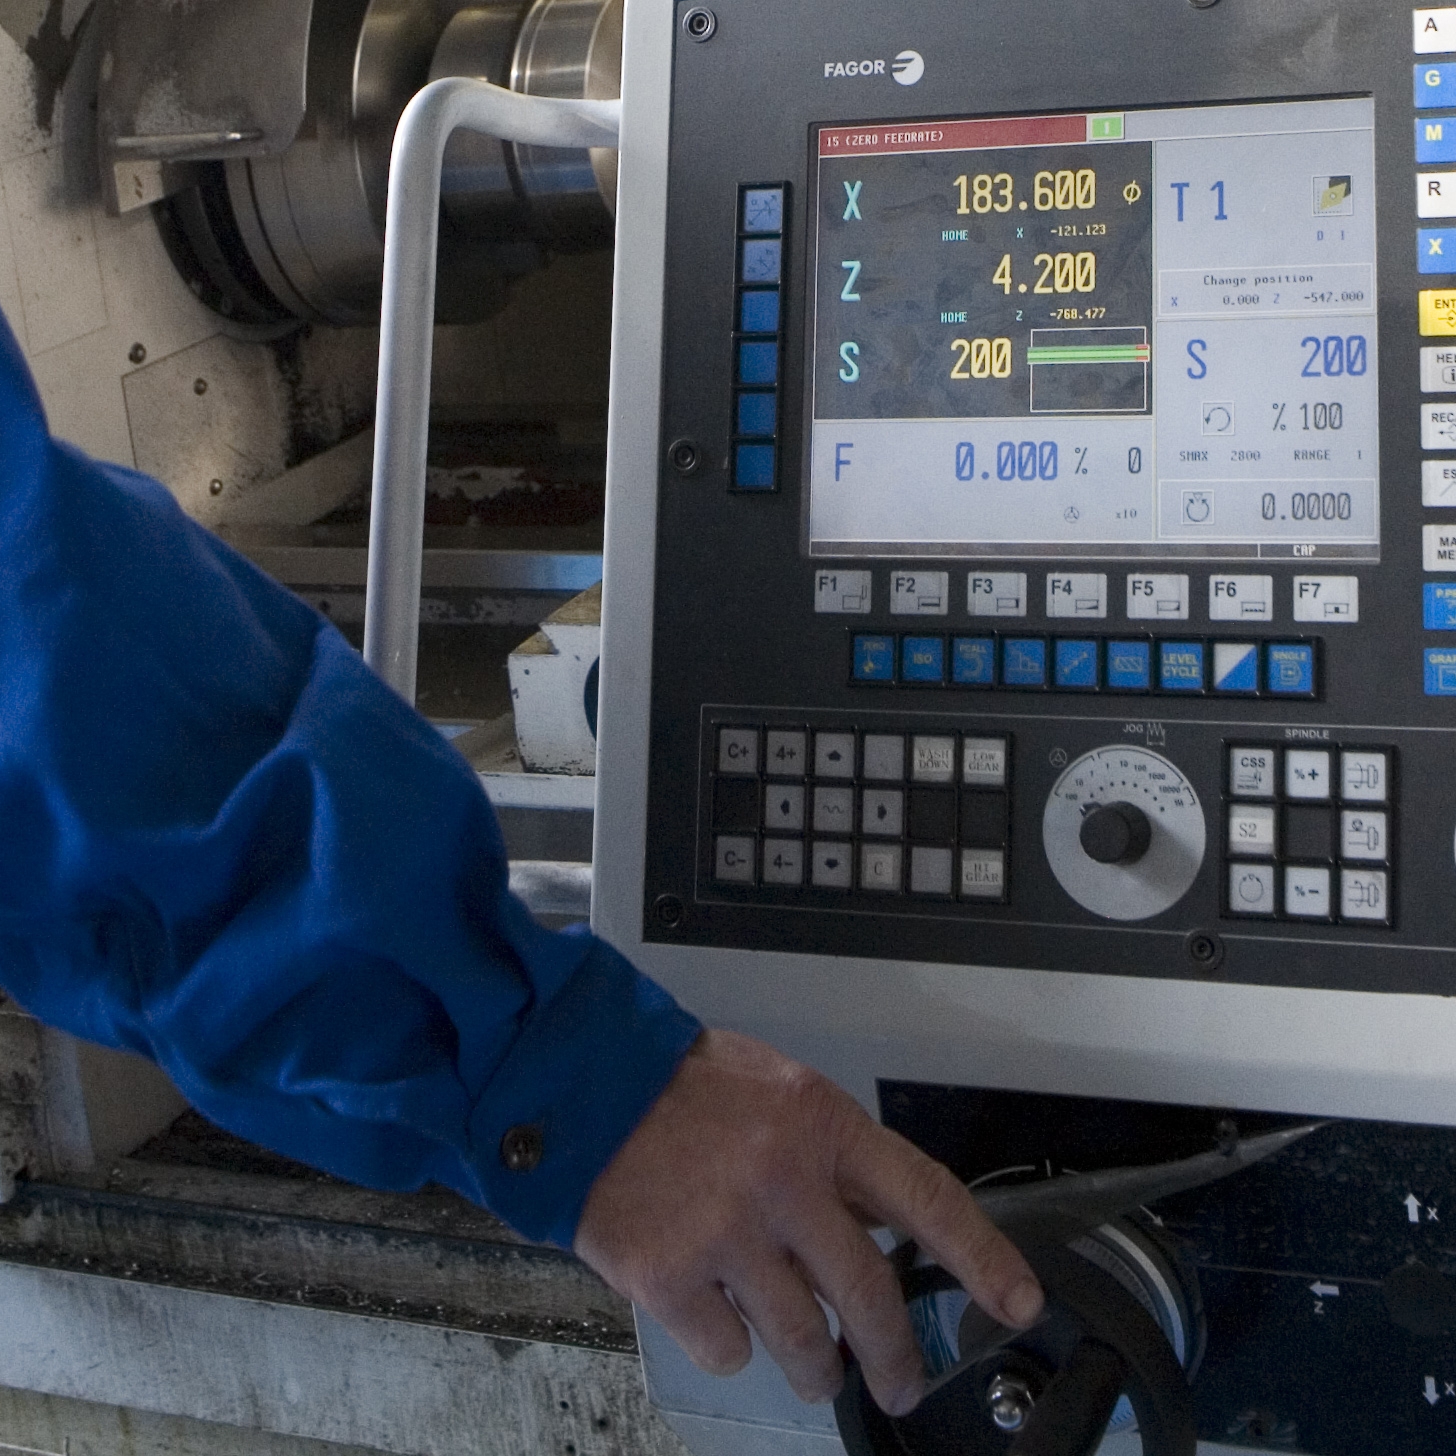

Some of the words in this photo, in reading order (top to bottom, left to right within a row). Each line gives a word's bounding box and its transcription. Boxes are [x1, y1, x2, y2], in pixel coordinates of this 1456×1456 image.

[1424, 18, 1438, 32] A
[824, 59, 885, 77] FAGOR
[1425, 70, 1440, 87] G
[885, 131, 944, 143] FEEDRATE)
[1426, 125, 1442, 141] M
[843, 180, 862, 220] X
[953, 169, 1095, 215] 183.600
[1429, 181, 1441, 196] R
[1170, 182, 1190, 222] T
[1210, 181, 1227, 220] 1
[942, 230, 968, 241] HOME
[1017, 228, 1023, 238] X
[1050, 225, 1106, 237] -121.123
[1428, 239, 1442, 255] X
[841, 260, 862, 301] Z
[992, 252, 1095, 295] 4.200
[1203, 275, 1247, 286] Change
[1255, 274, 1313, 286] position
[1171, 297, 1178, 306] X
[1223, 295, 1259, 305] 0.000
[1273, 294, 1280, 304] Z
[1304, 292, 1364, 303] -547.000
[941, 312, 967, 322] HOME
[1016, 311, 1023, 321] Z
[839, 342, 860, 383] S
[950, 338, 1012, 379] 200
[1186, 339, 1207, 379] S
[1301, 335, 1367, 377] 200
[1300, 402, 1343, 430] 100
[835, 443, 853, 481] F
[955, 441, 1058, 481] 0.000
[1074, 447, 1088, 474] %
[1128, 447, 1141, 474] 0
[1179, 451, 1208, 461] SMAX
[1231, 451, 1261, 461] 2800
[1294, 450, 1330, 460] RANGE
[1262, 493, 1351, 520] 0.0000
[1293, 545, 1316, 556] CAP
[818, 576, 838, 592] F1
[895, 578, 916, 593] F2
[972, 579, 993, 594] F3
[1051, 580, 1072, 595] F4
[1132, 580, 1153, 596] F5
[1215, 581, 1236, 597] F6
[1298, 582, 1321, 598] F7
[1163, 654, 1197, 664] LEVEL
[1163, 666, 1199, 677] CYCLE
[1123, 724, 1144, 732] JOG
[1285, 729, 1330, 739] SPINDLE
[728, 744, 749, 759] C+
[777, 746, 796, 760] 4+
[969, 763, 999, 771] GEAR
[1241, 757, 1265, 768] CSS
[1239, 823, 1256, 838] S2
[1427, 1207, 1439, 1221] X
[1314, 1302, 1324, 1314] Z
[1445, 1382, 1455, 1395] X
